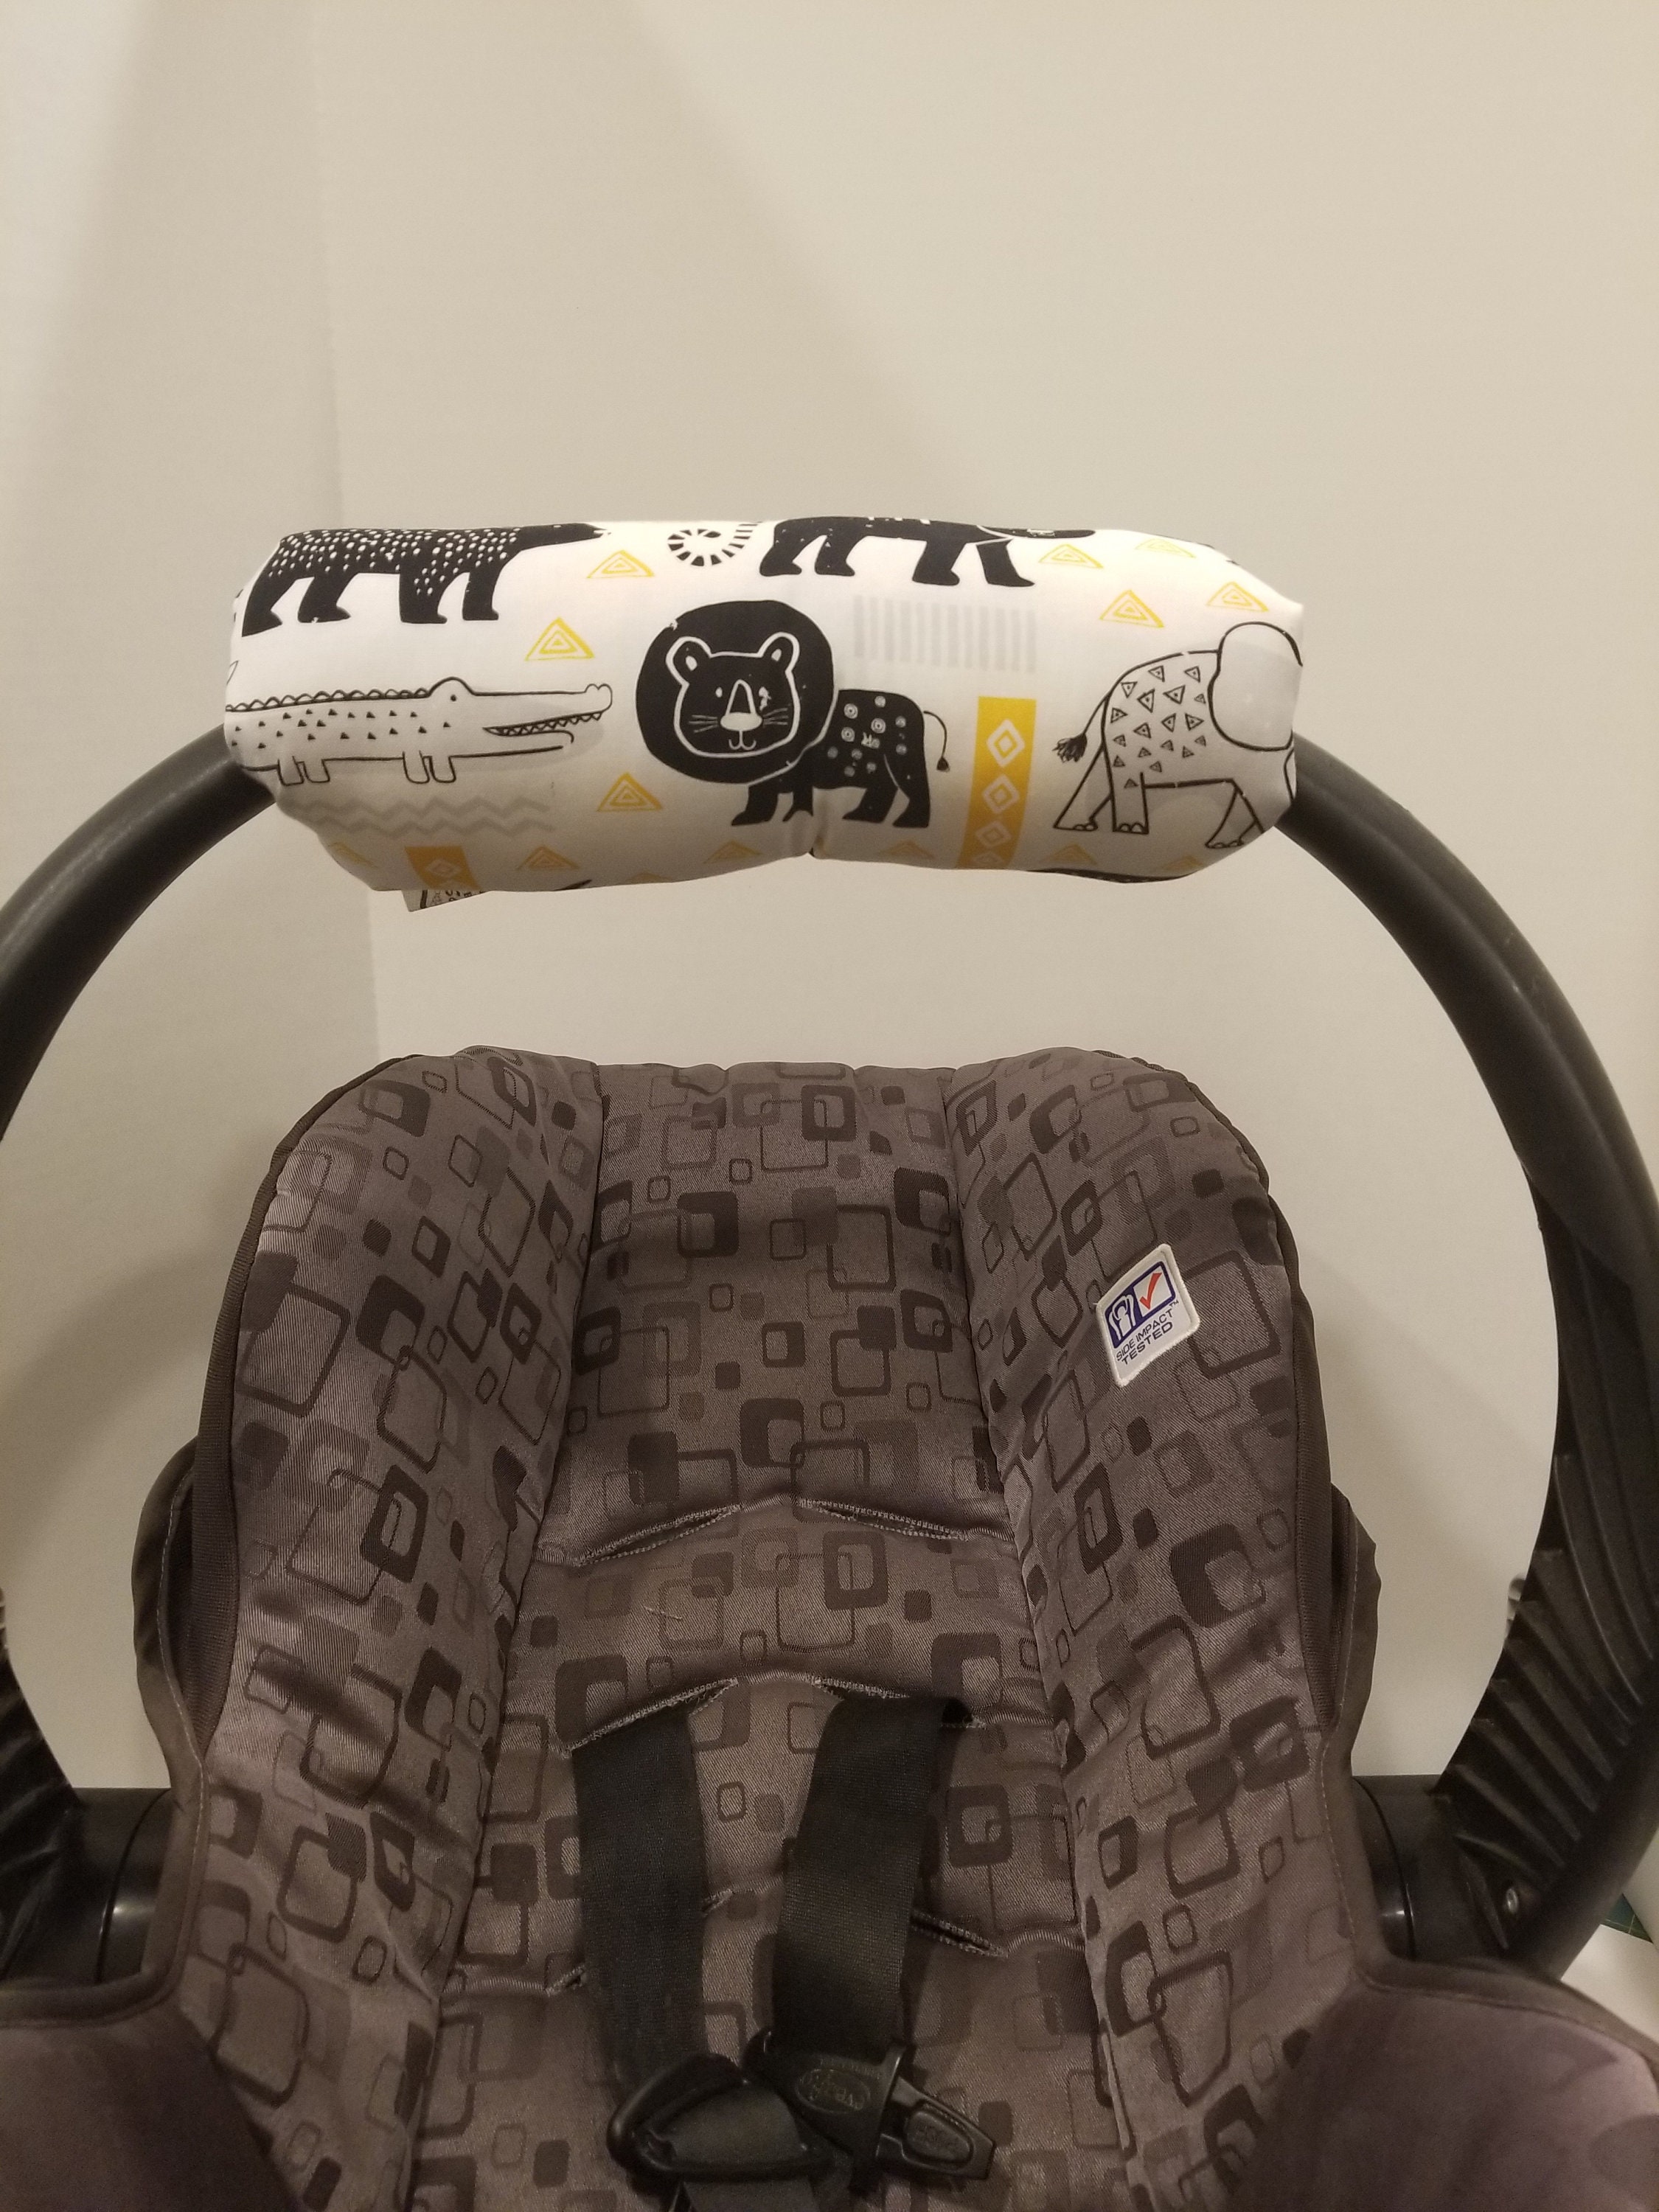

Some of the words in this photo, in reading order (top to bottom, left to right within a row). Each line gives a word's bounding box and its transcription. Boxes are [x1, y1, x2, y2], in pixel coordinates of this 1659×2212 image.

[1116, 1338, 1135, 1361] SIDE
[1135, 1309, 1173, 1341] IMPACT
[1121, 1322, 1173, 1365] TESTED
